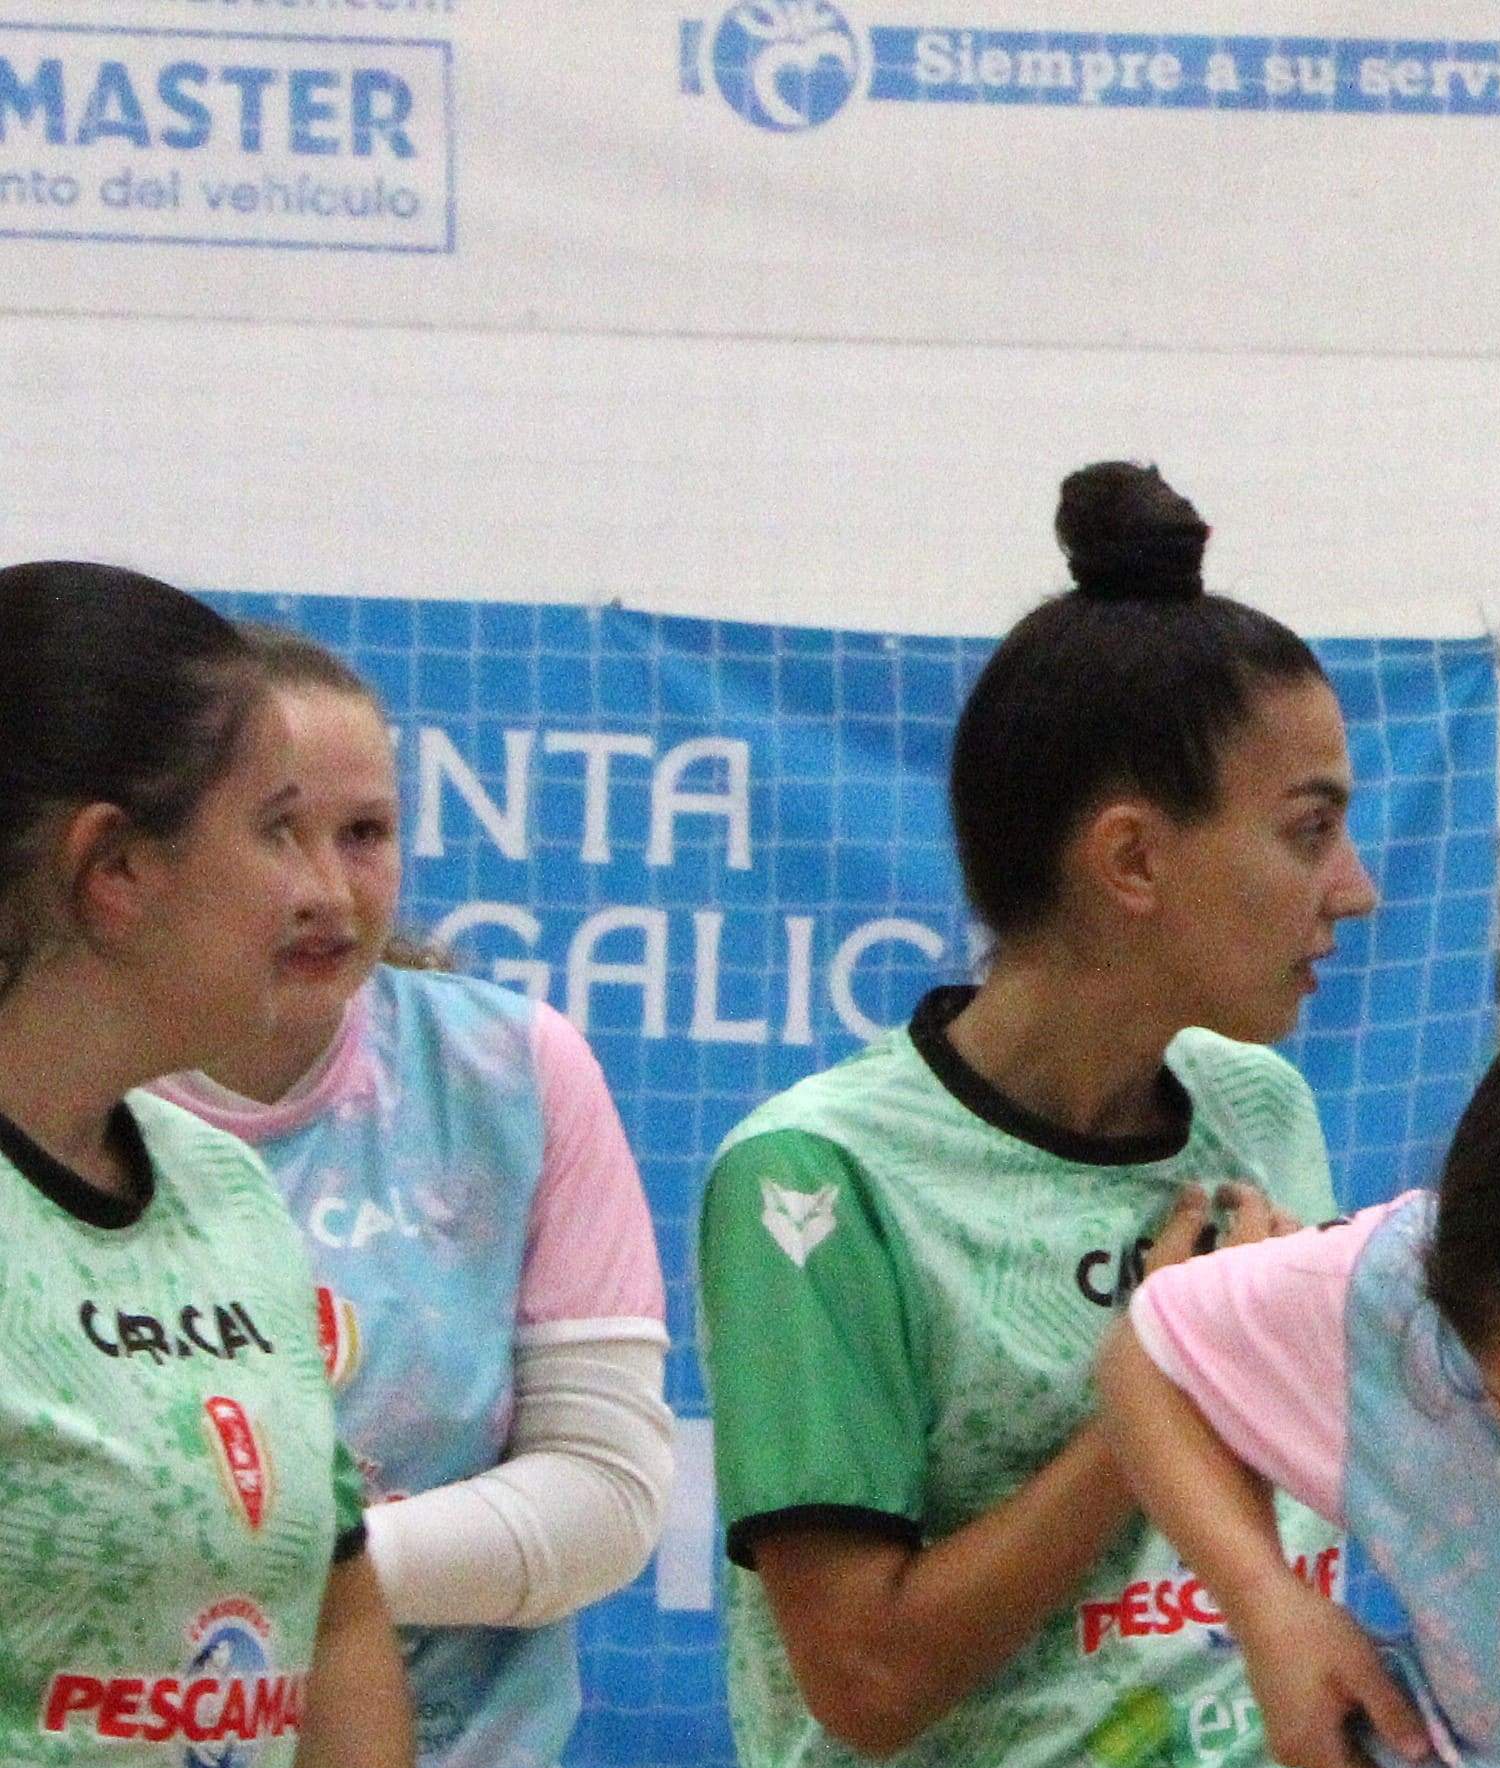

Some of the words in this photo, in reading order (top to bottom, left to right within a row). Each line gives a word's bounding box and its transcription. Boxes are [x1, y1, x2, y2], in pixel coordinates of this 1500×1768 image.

[914, 38, 1182, 102] Siempre
[1204, 57, 1240, 93] a
[1264, 60, 1337, 96] su
[99, 168, 181, 209] del
[412, 724, 753, 870] NTA
[428, 902, 1000, 1045] GALIC
[43, 1673, 302, 1743] PESCAMA
